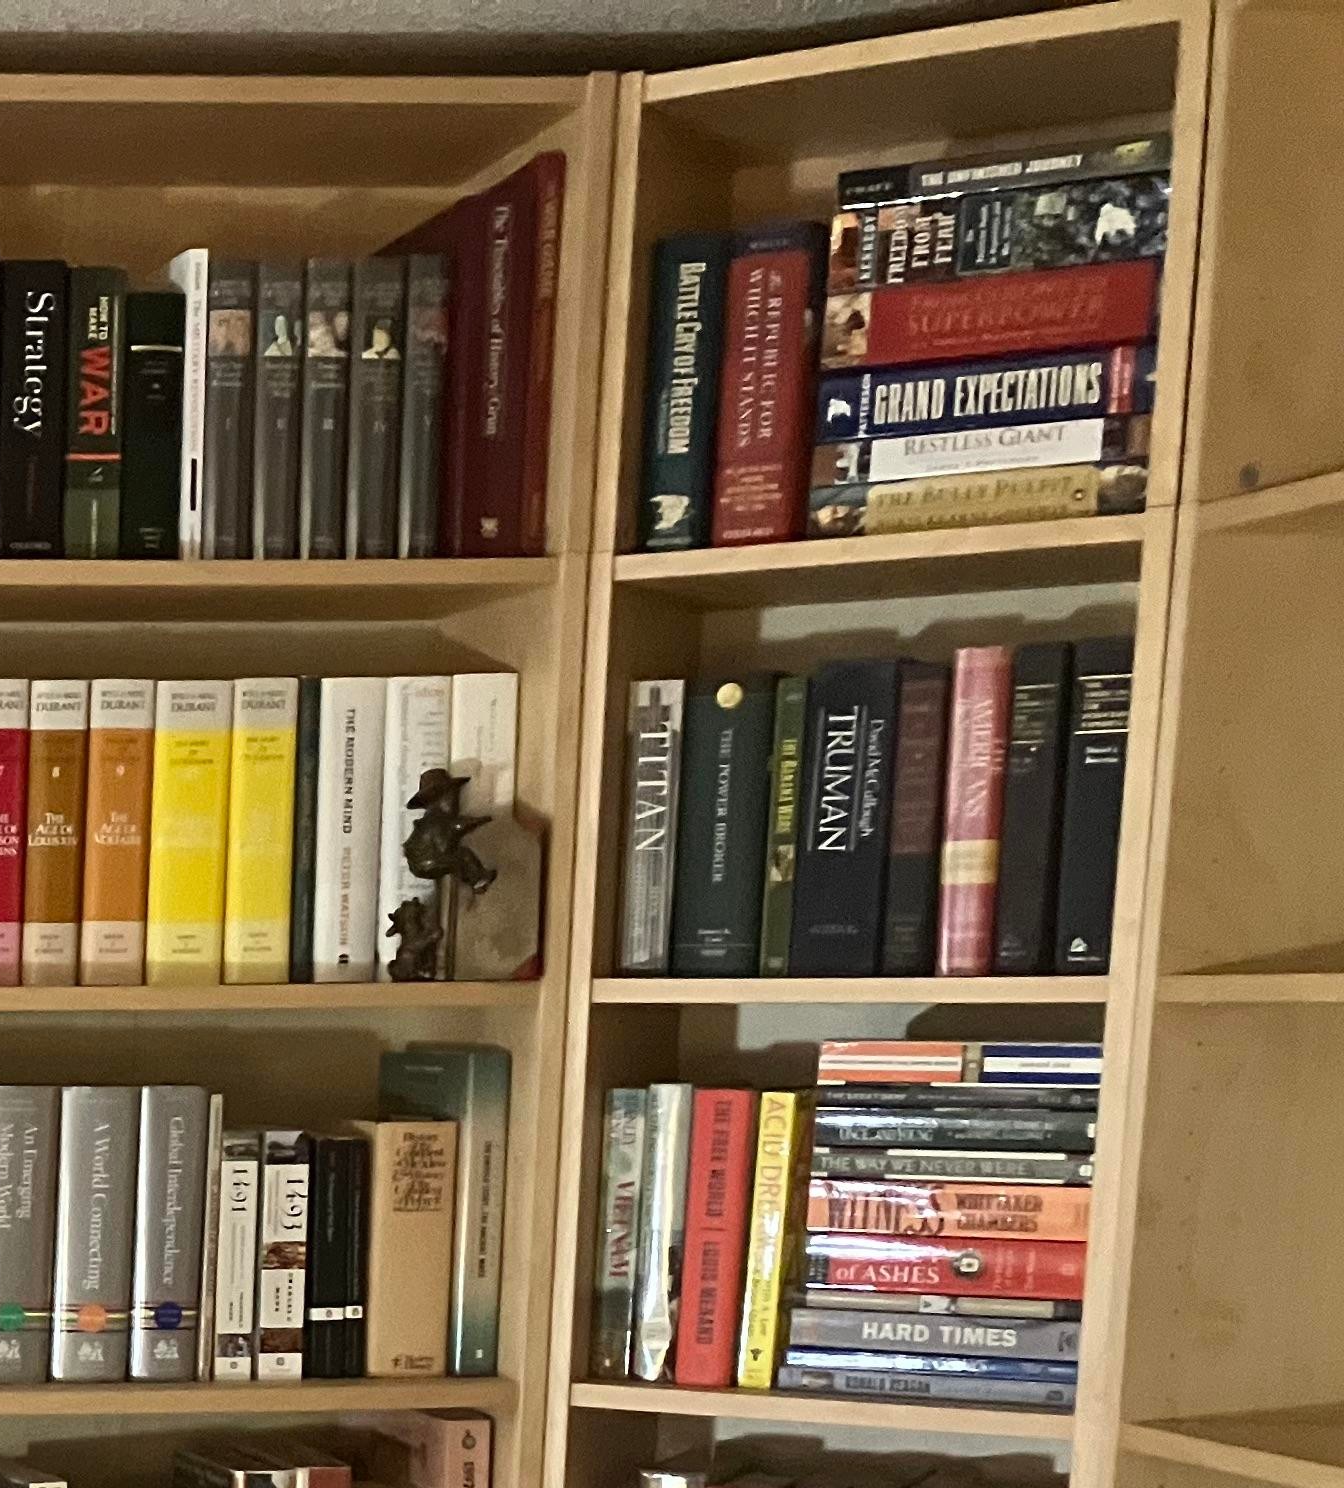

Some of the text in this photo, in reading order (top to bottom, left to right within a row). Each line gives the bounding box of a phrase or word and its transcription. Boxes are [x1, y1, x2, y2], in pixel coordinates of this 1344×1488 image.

[13, 291, 53, 433] Strategy
[78, 346, 110, 437] WAR
[874, 363, 1101, 425] GRAND EXPECTATIONS
[904, 425, 1067, 457] RESTLESS GIANT
[634, 720, 670, 853] TITAN
[818, 706, 858, 853] TRUMAN
[231, 1168, 247, 1213] 1491
[285, 1176, 306, 1231] 1493
[836, 1264, 940, 1284] of ASHES
[862, 1322, 1017, 1347] HARD TIMES
